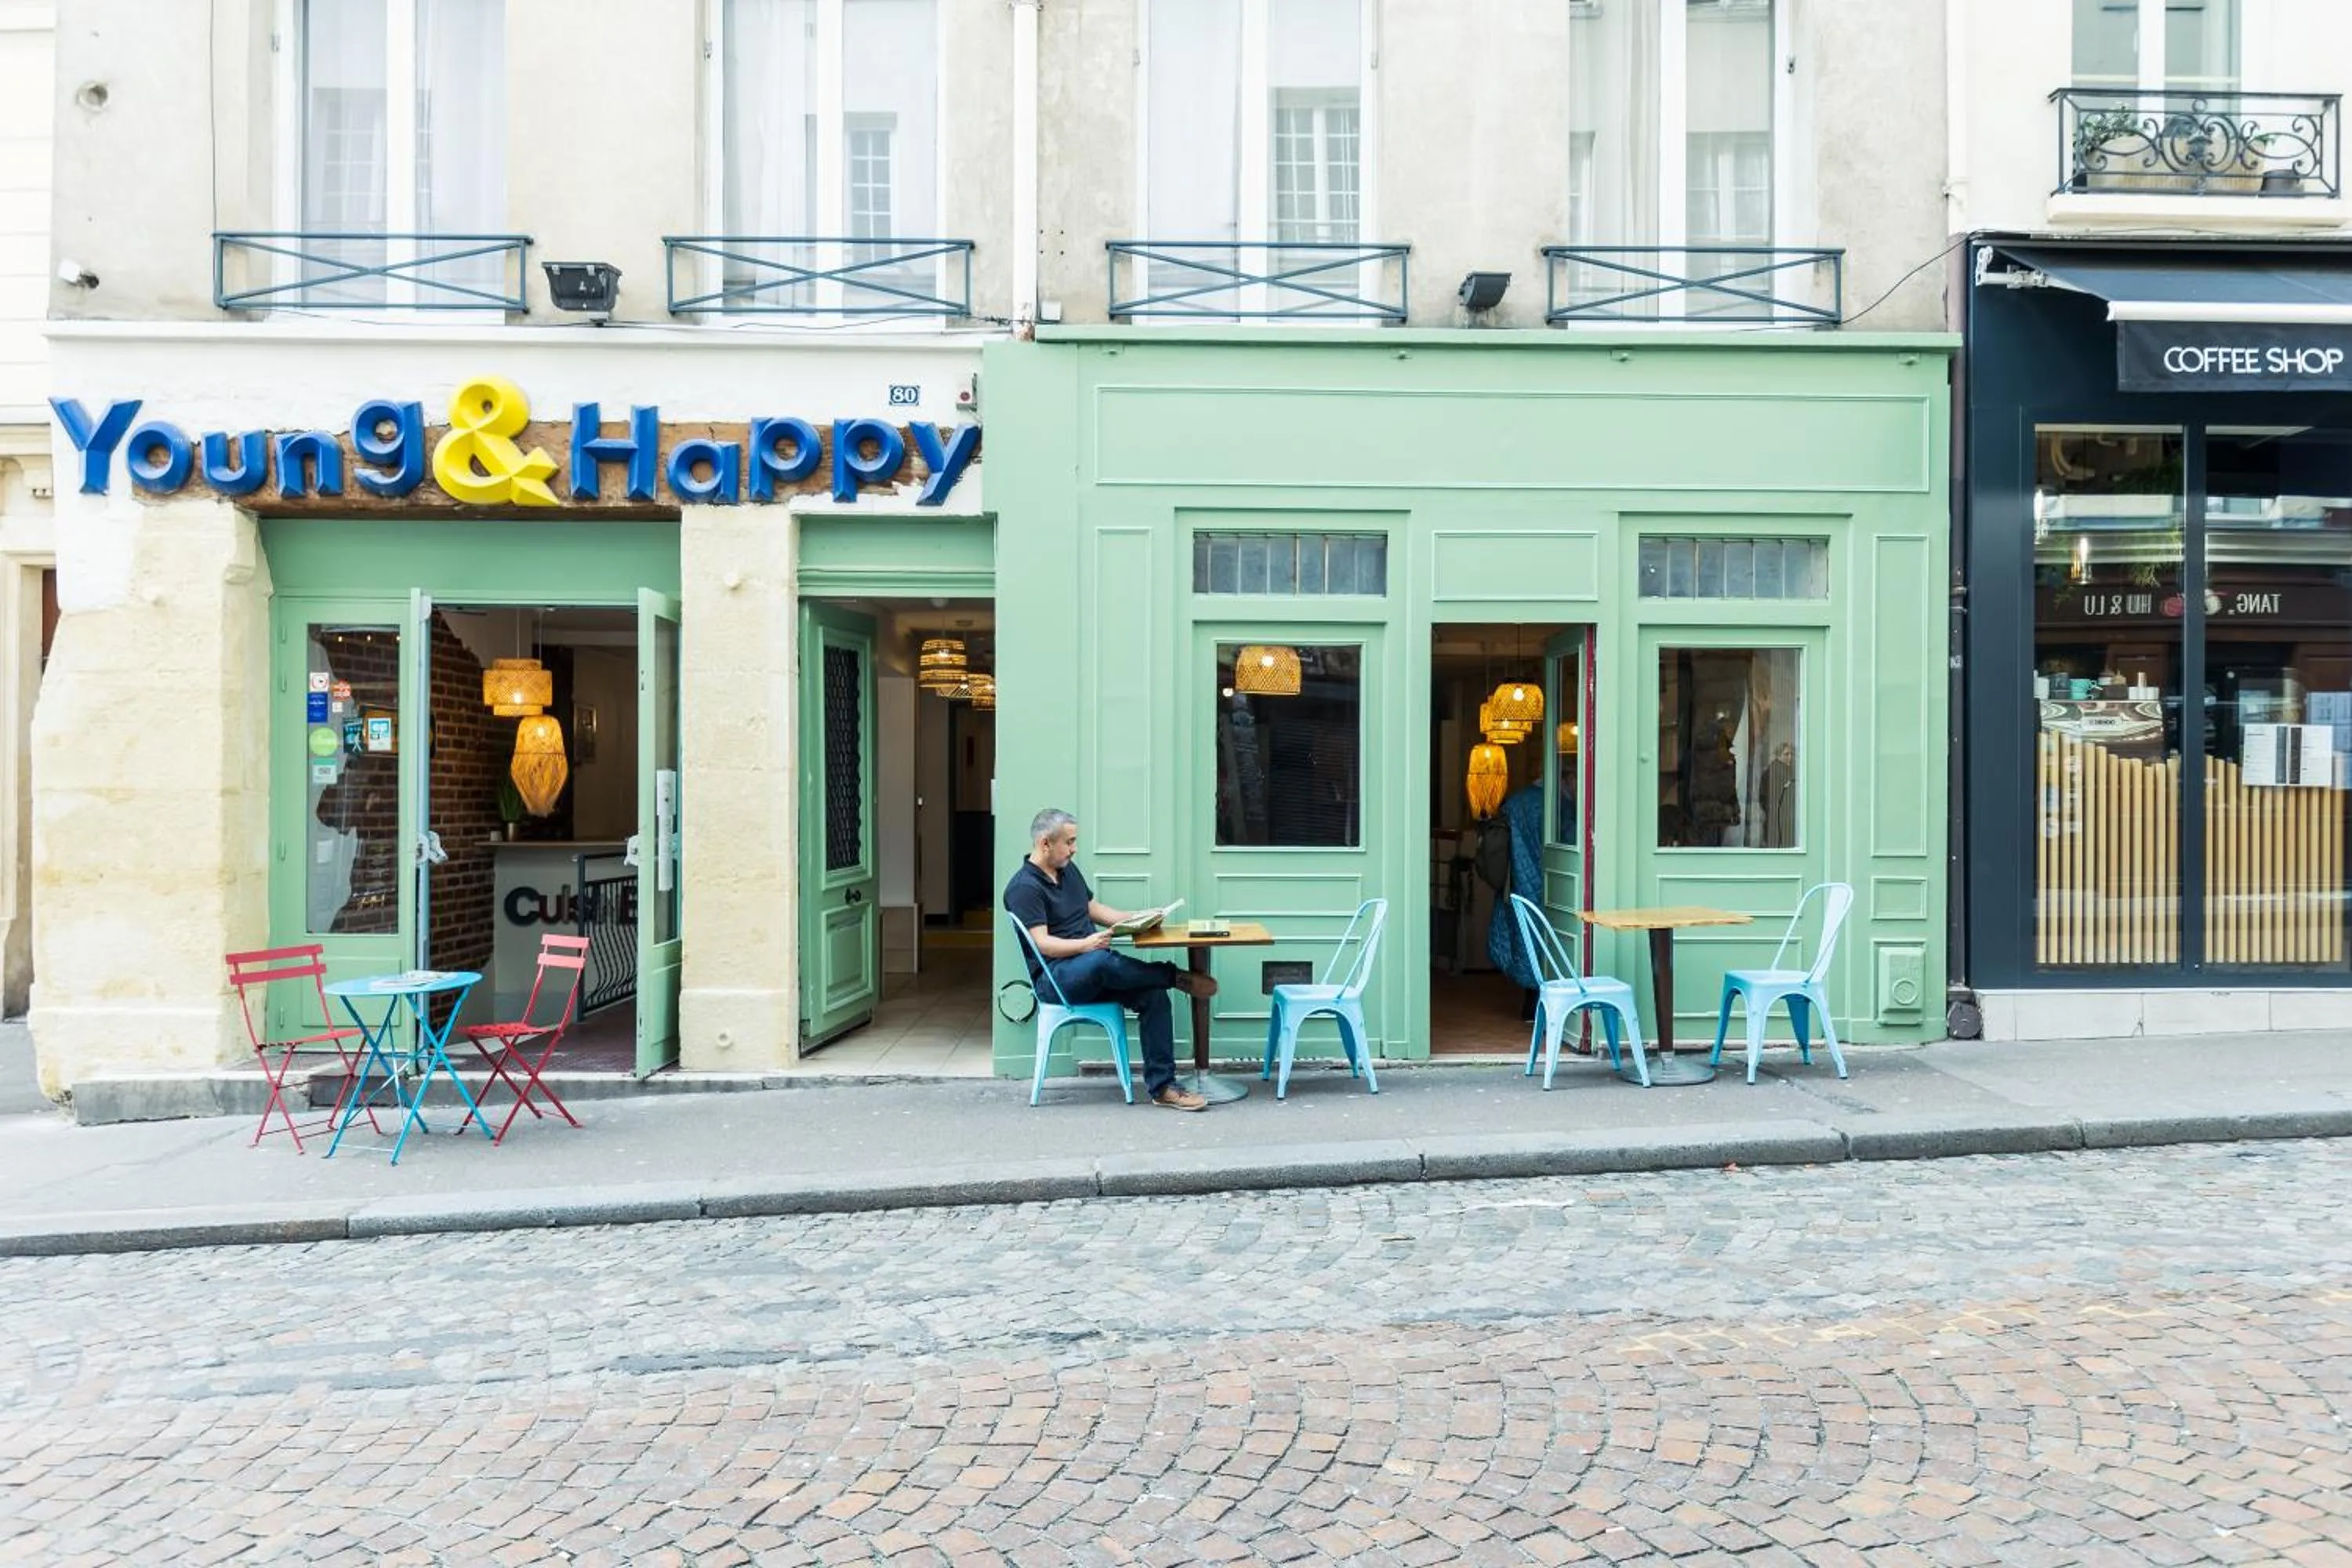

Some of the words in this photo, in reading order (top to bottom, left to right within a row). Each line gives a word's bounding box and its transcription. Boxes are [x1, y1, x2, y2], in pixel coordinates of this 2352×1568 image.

[2163, 347, 2262, 373] COFFEE
[2266, 347, 2344, 374] SHOP
[892, 387, 917, 402] 80
